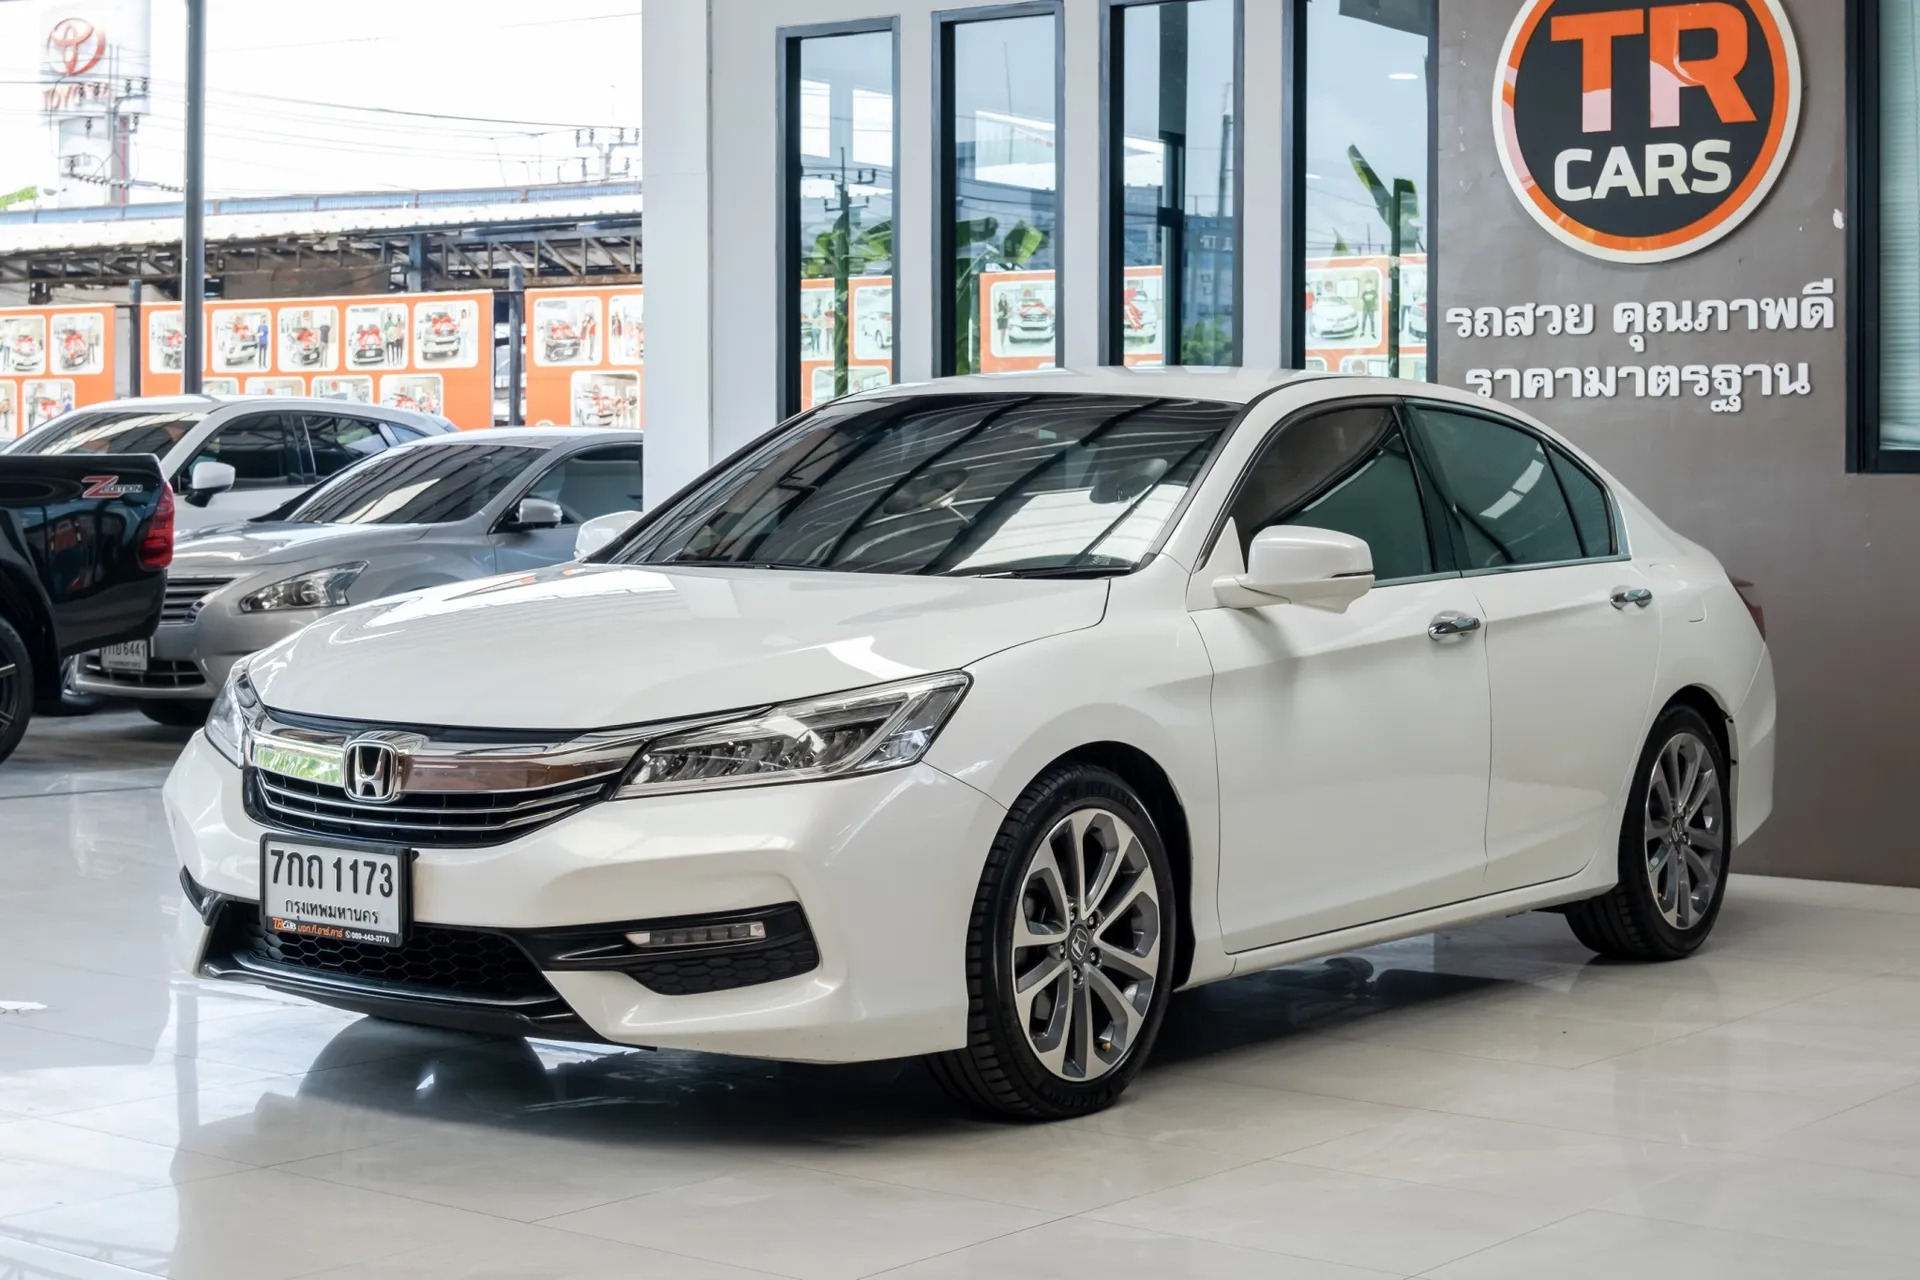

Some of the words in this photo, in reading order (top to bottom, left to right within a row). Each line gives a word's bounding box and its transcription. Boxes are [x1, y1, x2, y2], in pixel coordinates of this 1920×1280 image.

[1550, 1, 1757, 133] TR
[1553, 139, 1732, 202] CARS
[1446, 300, 1594, 338] รถสวย
[1612, 277, 1835, 353] คุณภาพดี
[1465, 360, 1811, 413] ราคามาตรฐาน
[270, 849, 323, 889] 7กถ
[333, 857, 393, 898] 1173
[284, 899, 379, 925] กรุงเทพมหานคร
